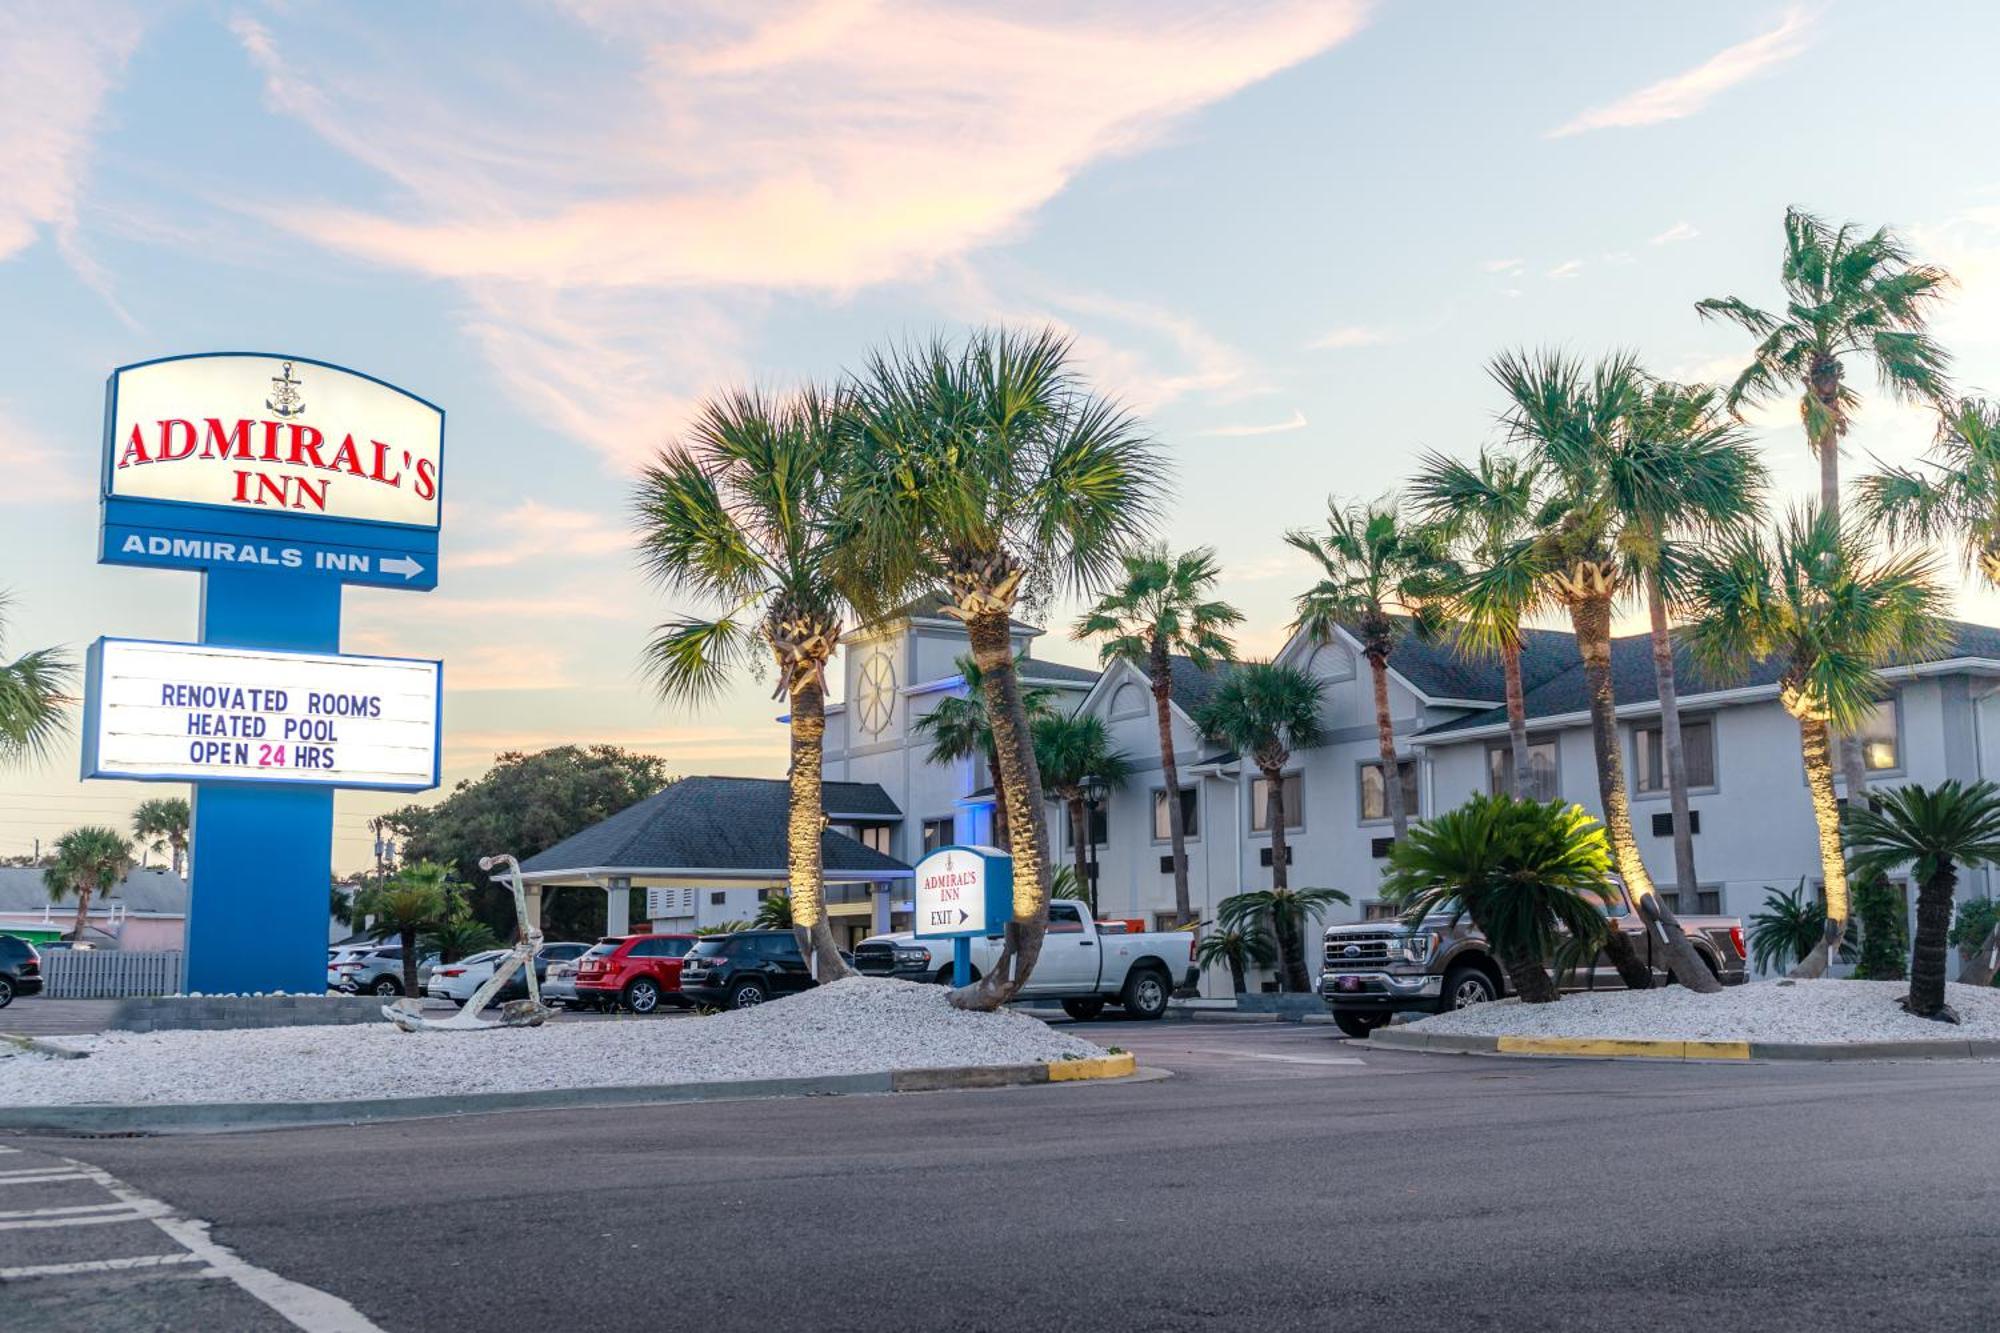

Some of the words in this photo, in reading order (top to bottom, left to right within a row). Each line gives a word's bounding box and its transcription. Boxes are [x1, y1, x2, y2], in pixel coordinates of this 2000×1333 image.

[118, 418, 436, 501] ADMIRAL'S
[232, 470, 331, 511] INN
[122, 535, 302, 567] ADMIRALS
[315, 551, 369, 572] INN
[162, 684, 288, 712] RENOVATED
[308, 692, 381, 717] ROOMS
[187, 713, 266, 738] HEATED
[284, 719, 337, 742] POOL
[190, 741, 249, 765] OPEN
[258, 744, 286, 767] 24
[294, 746, 335, 769] HRS
[923, 871, 977, 890] ADMIRAL'S
[940, 887, 960, 902] INN
[931, 909, 953, 926] EXIT
